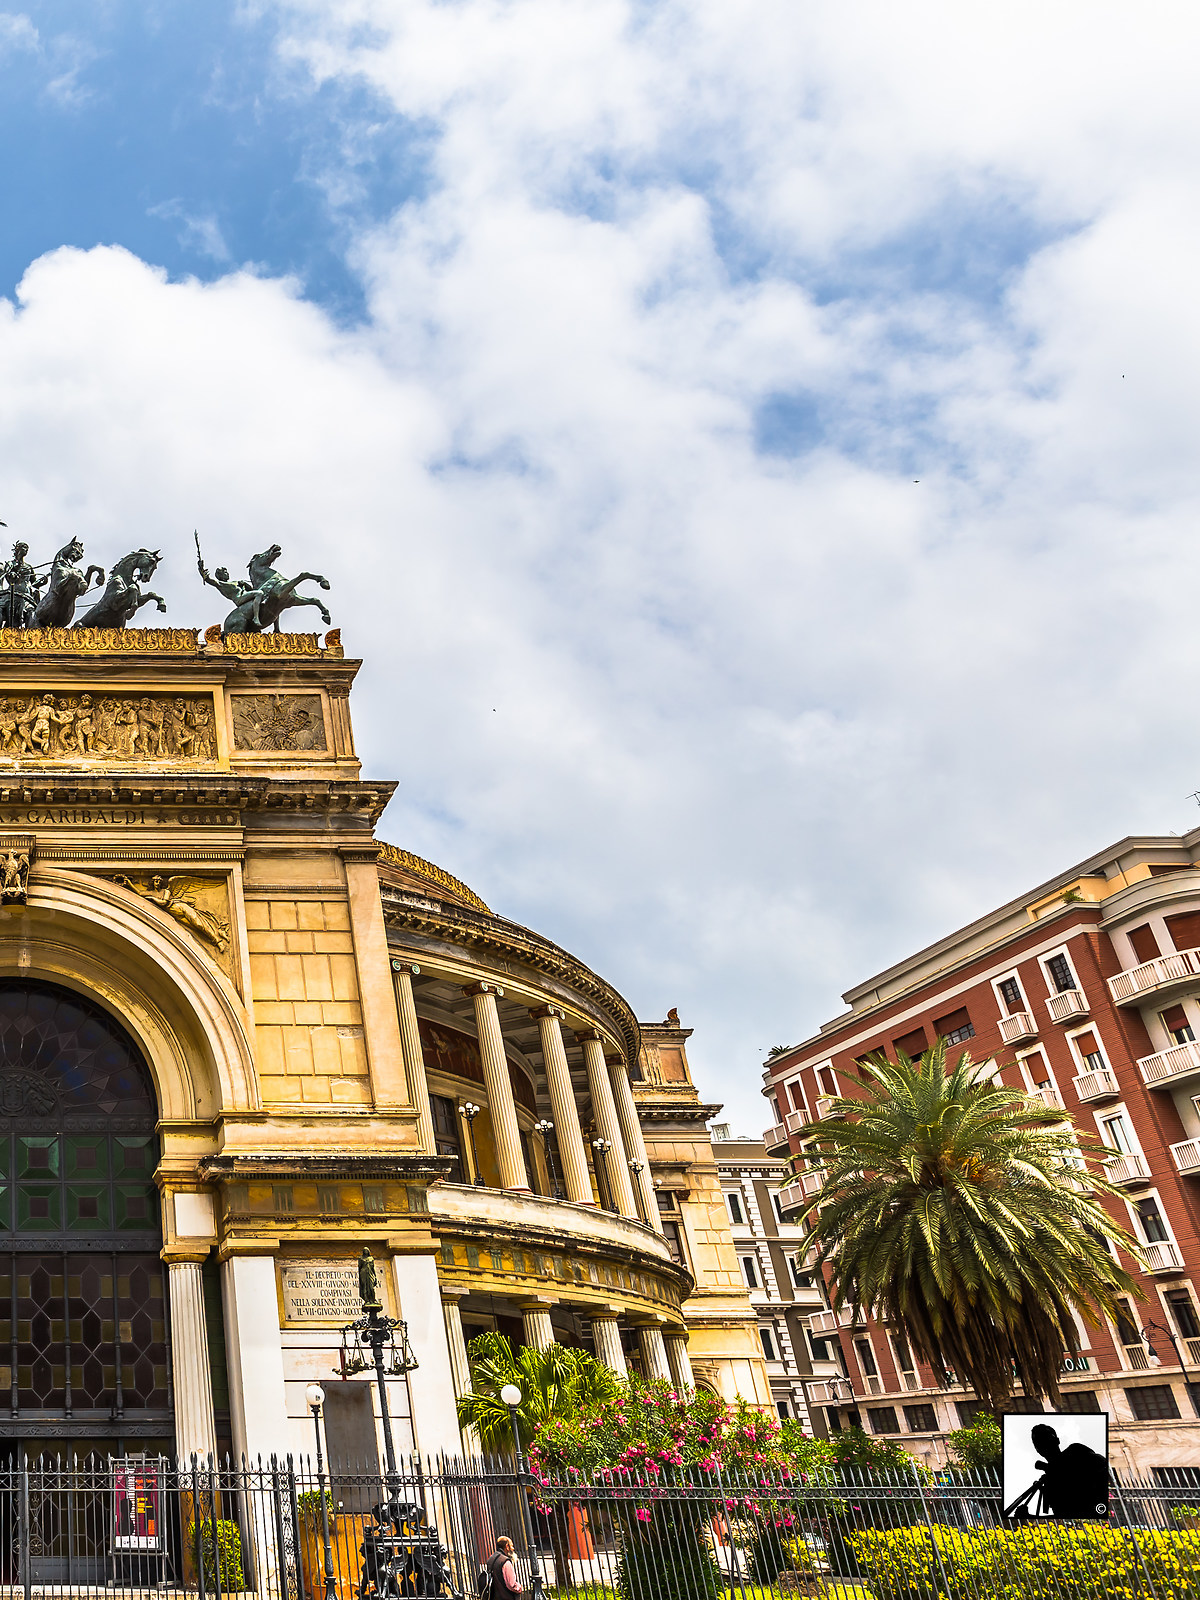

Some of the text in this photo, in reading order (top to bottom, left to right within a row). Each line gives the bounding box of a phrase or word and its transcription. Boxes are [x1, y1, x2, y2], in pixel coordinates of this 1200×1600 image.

[26, 808, 147, 824] GARIBALDI
[305, 1271, 312, 1279] IL
[315, 1271, 341, 1279] DECRETO
[288, 1280, 298, 1288] DEL
[291, 1298, 310, 1307] NELLA
[311, 1298, 336, 1307] SOLENNE
[297, 1308, 303, 1316] IL
